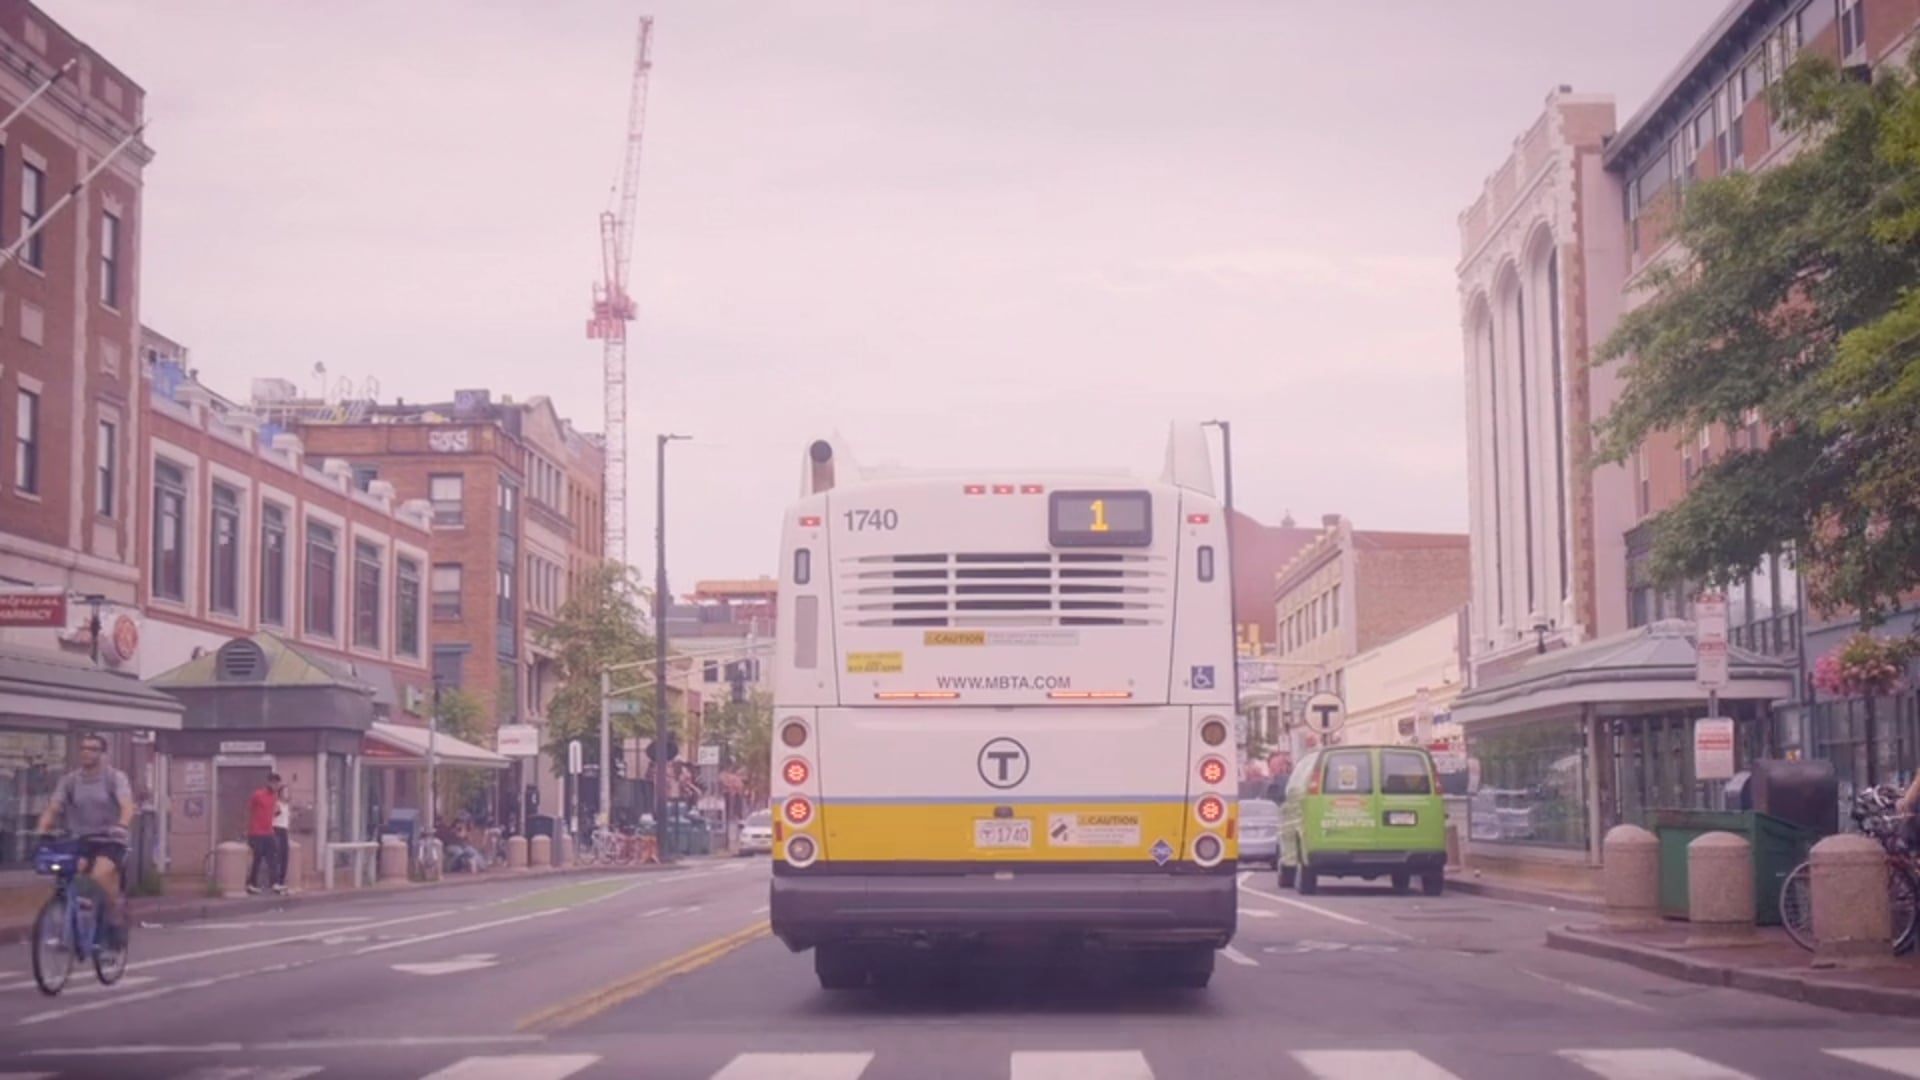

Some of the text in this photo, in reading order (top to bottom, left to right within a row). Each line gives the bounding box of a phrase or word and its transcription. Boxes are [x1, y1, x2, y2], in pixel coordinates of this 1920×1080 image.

[843, 509, 899, 531] 1740
[1089, 500, 1109, 531] 1
[934, 633, 985, 644] CAUTION
[937, 676, 1071, 689] WWW.MBTA.COM
[1312, 704, 1338, 728] T
[988, 752, 1019, 780] T
[1088, 815, 1139, 825] CAUTION
[997, 827, 1029, 842] 1740
